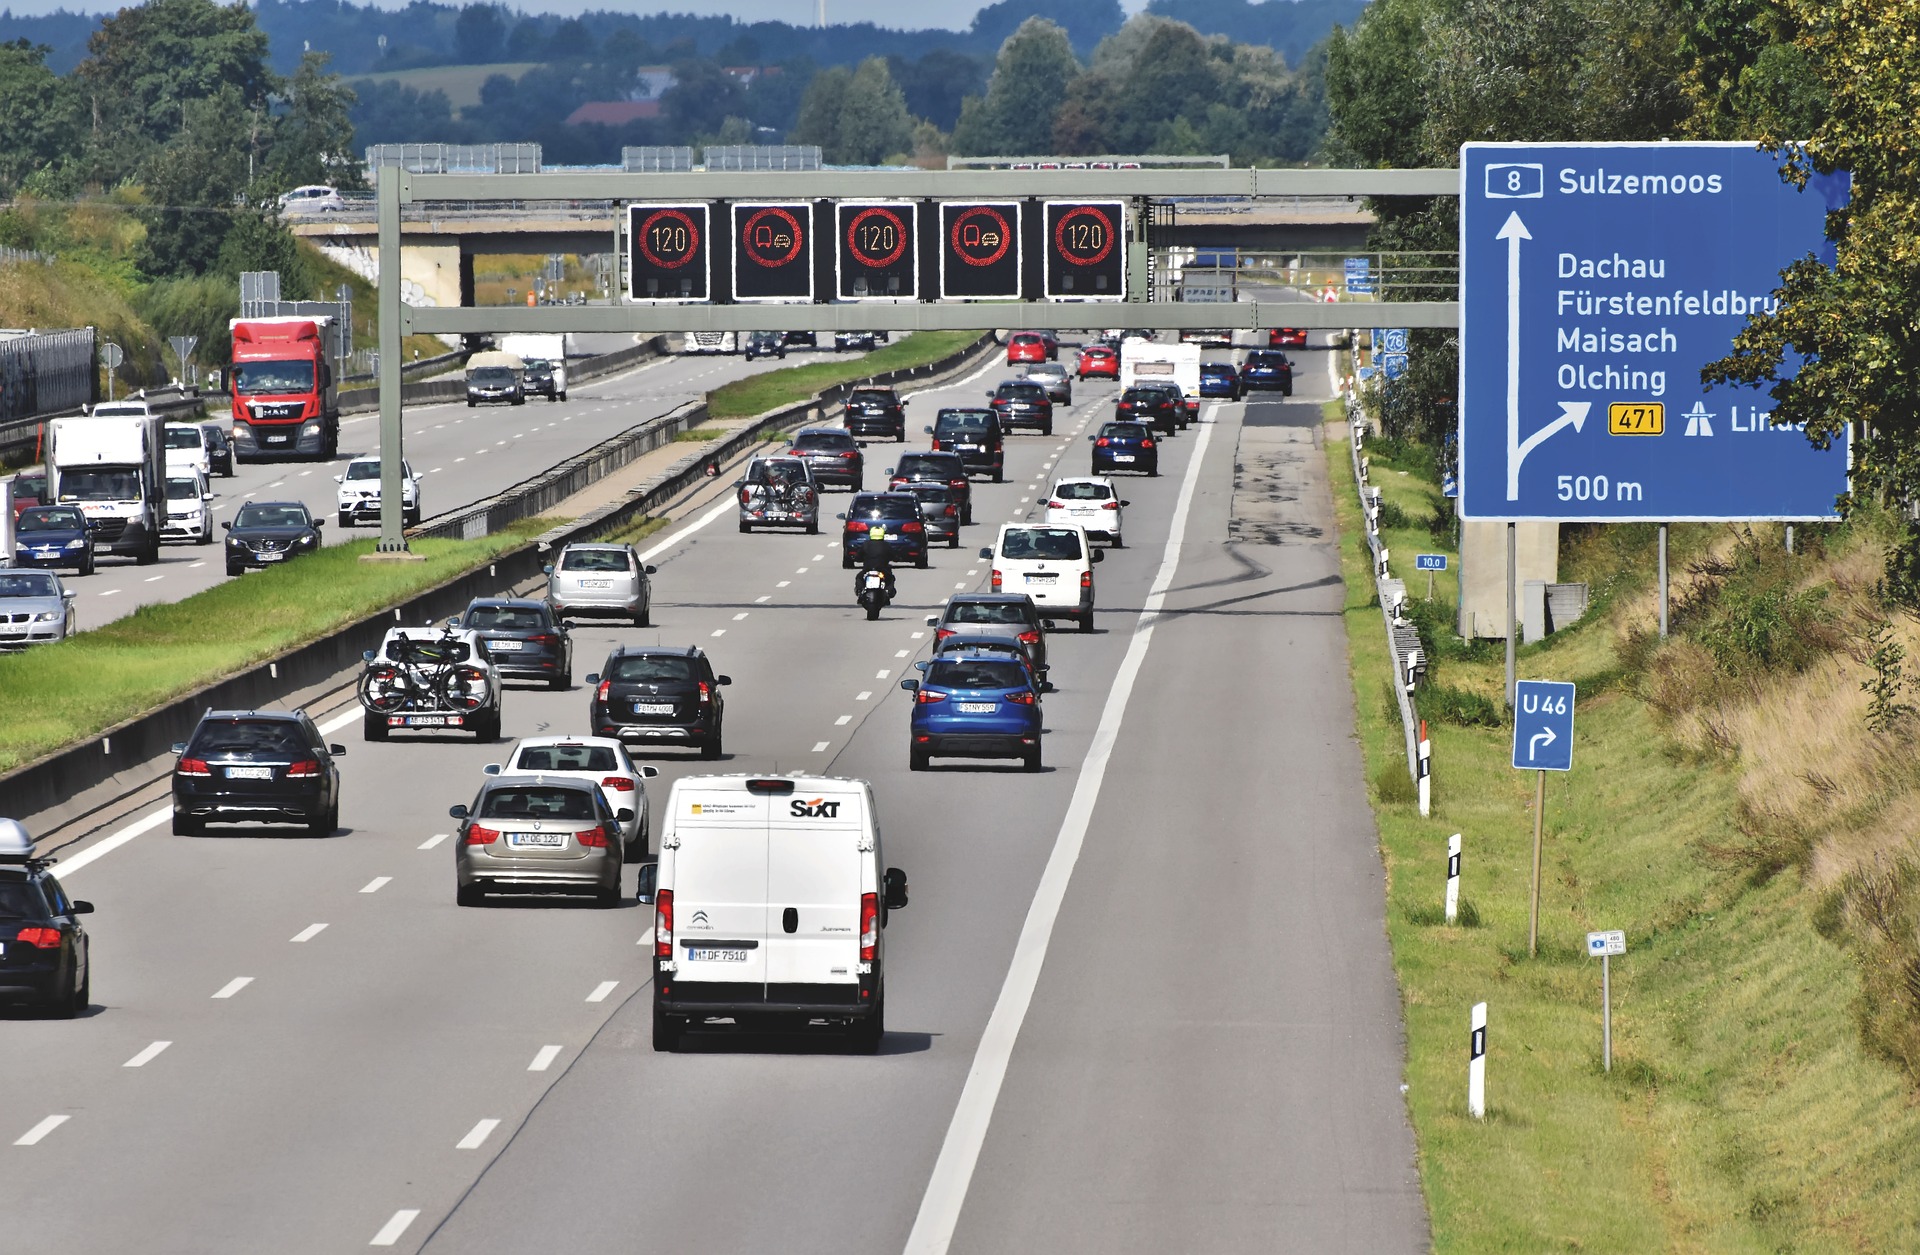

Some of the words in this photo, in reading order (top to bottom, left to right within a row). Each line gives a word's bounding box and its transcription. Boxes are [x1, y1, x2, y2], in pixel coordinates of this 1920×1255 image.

[1507, 170, 1521, 192] 8
[1559, 167, 1723, 195] Sulzemoos
[652, 227, 686, 252] 120
[861, 225, 894, 251] 120
[1068, 224, 1102, 249] 120
[1558, 252, 1665, 279] Dachau
[1557, 289, 1779, 316] Fürstenfeldbru
[1557, 326, 1677, 353] Maisach
[1557, 363, 1666, 397] Olching
[264, 405, 289, 415] MAN
[1619, 408, 1655, 429] 471
[1557, 474, 1609, 501] 500
[1616, 481, 1643, 501] m
[1523, 694, 1539, 714] U
[1541, 695, 1567, 715] 46
[694, 951, 701, 959] M
[707, 951, 720, 960] DF
[722, 951, 747, 961] 7510
